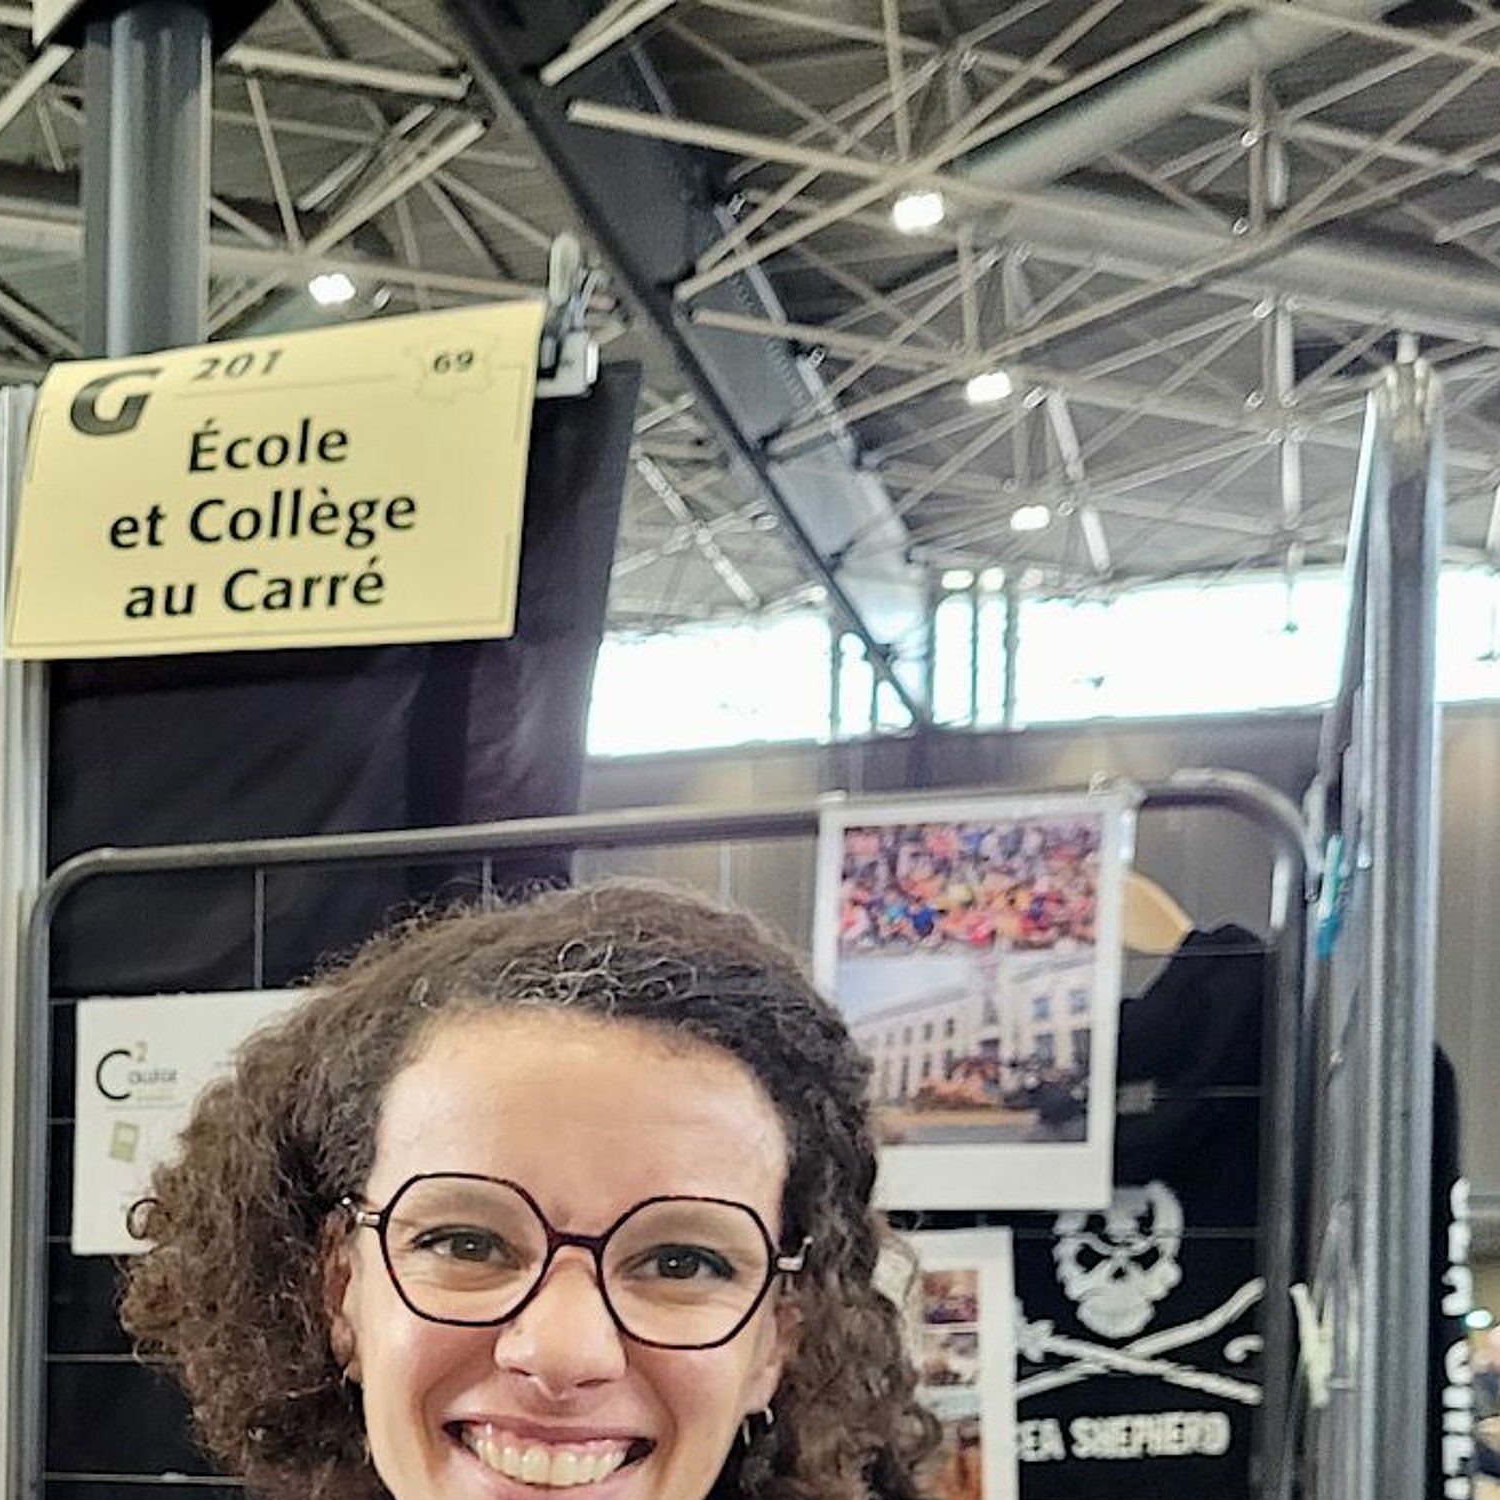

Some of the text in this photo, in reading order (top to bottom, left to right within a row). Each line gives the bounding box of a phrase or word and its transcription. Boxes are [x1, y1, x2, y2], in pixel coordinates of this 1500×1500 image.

[432, 351, 475, 375] 69
[70, 349, 284, 437] G 201
[189, 418, 349, 473] École
[110, 488, 417, 549] et Collège
[125, 557, 386, 619] au Carré
[1018, 1411, 1231, 1461] EA SHEPHERD
